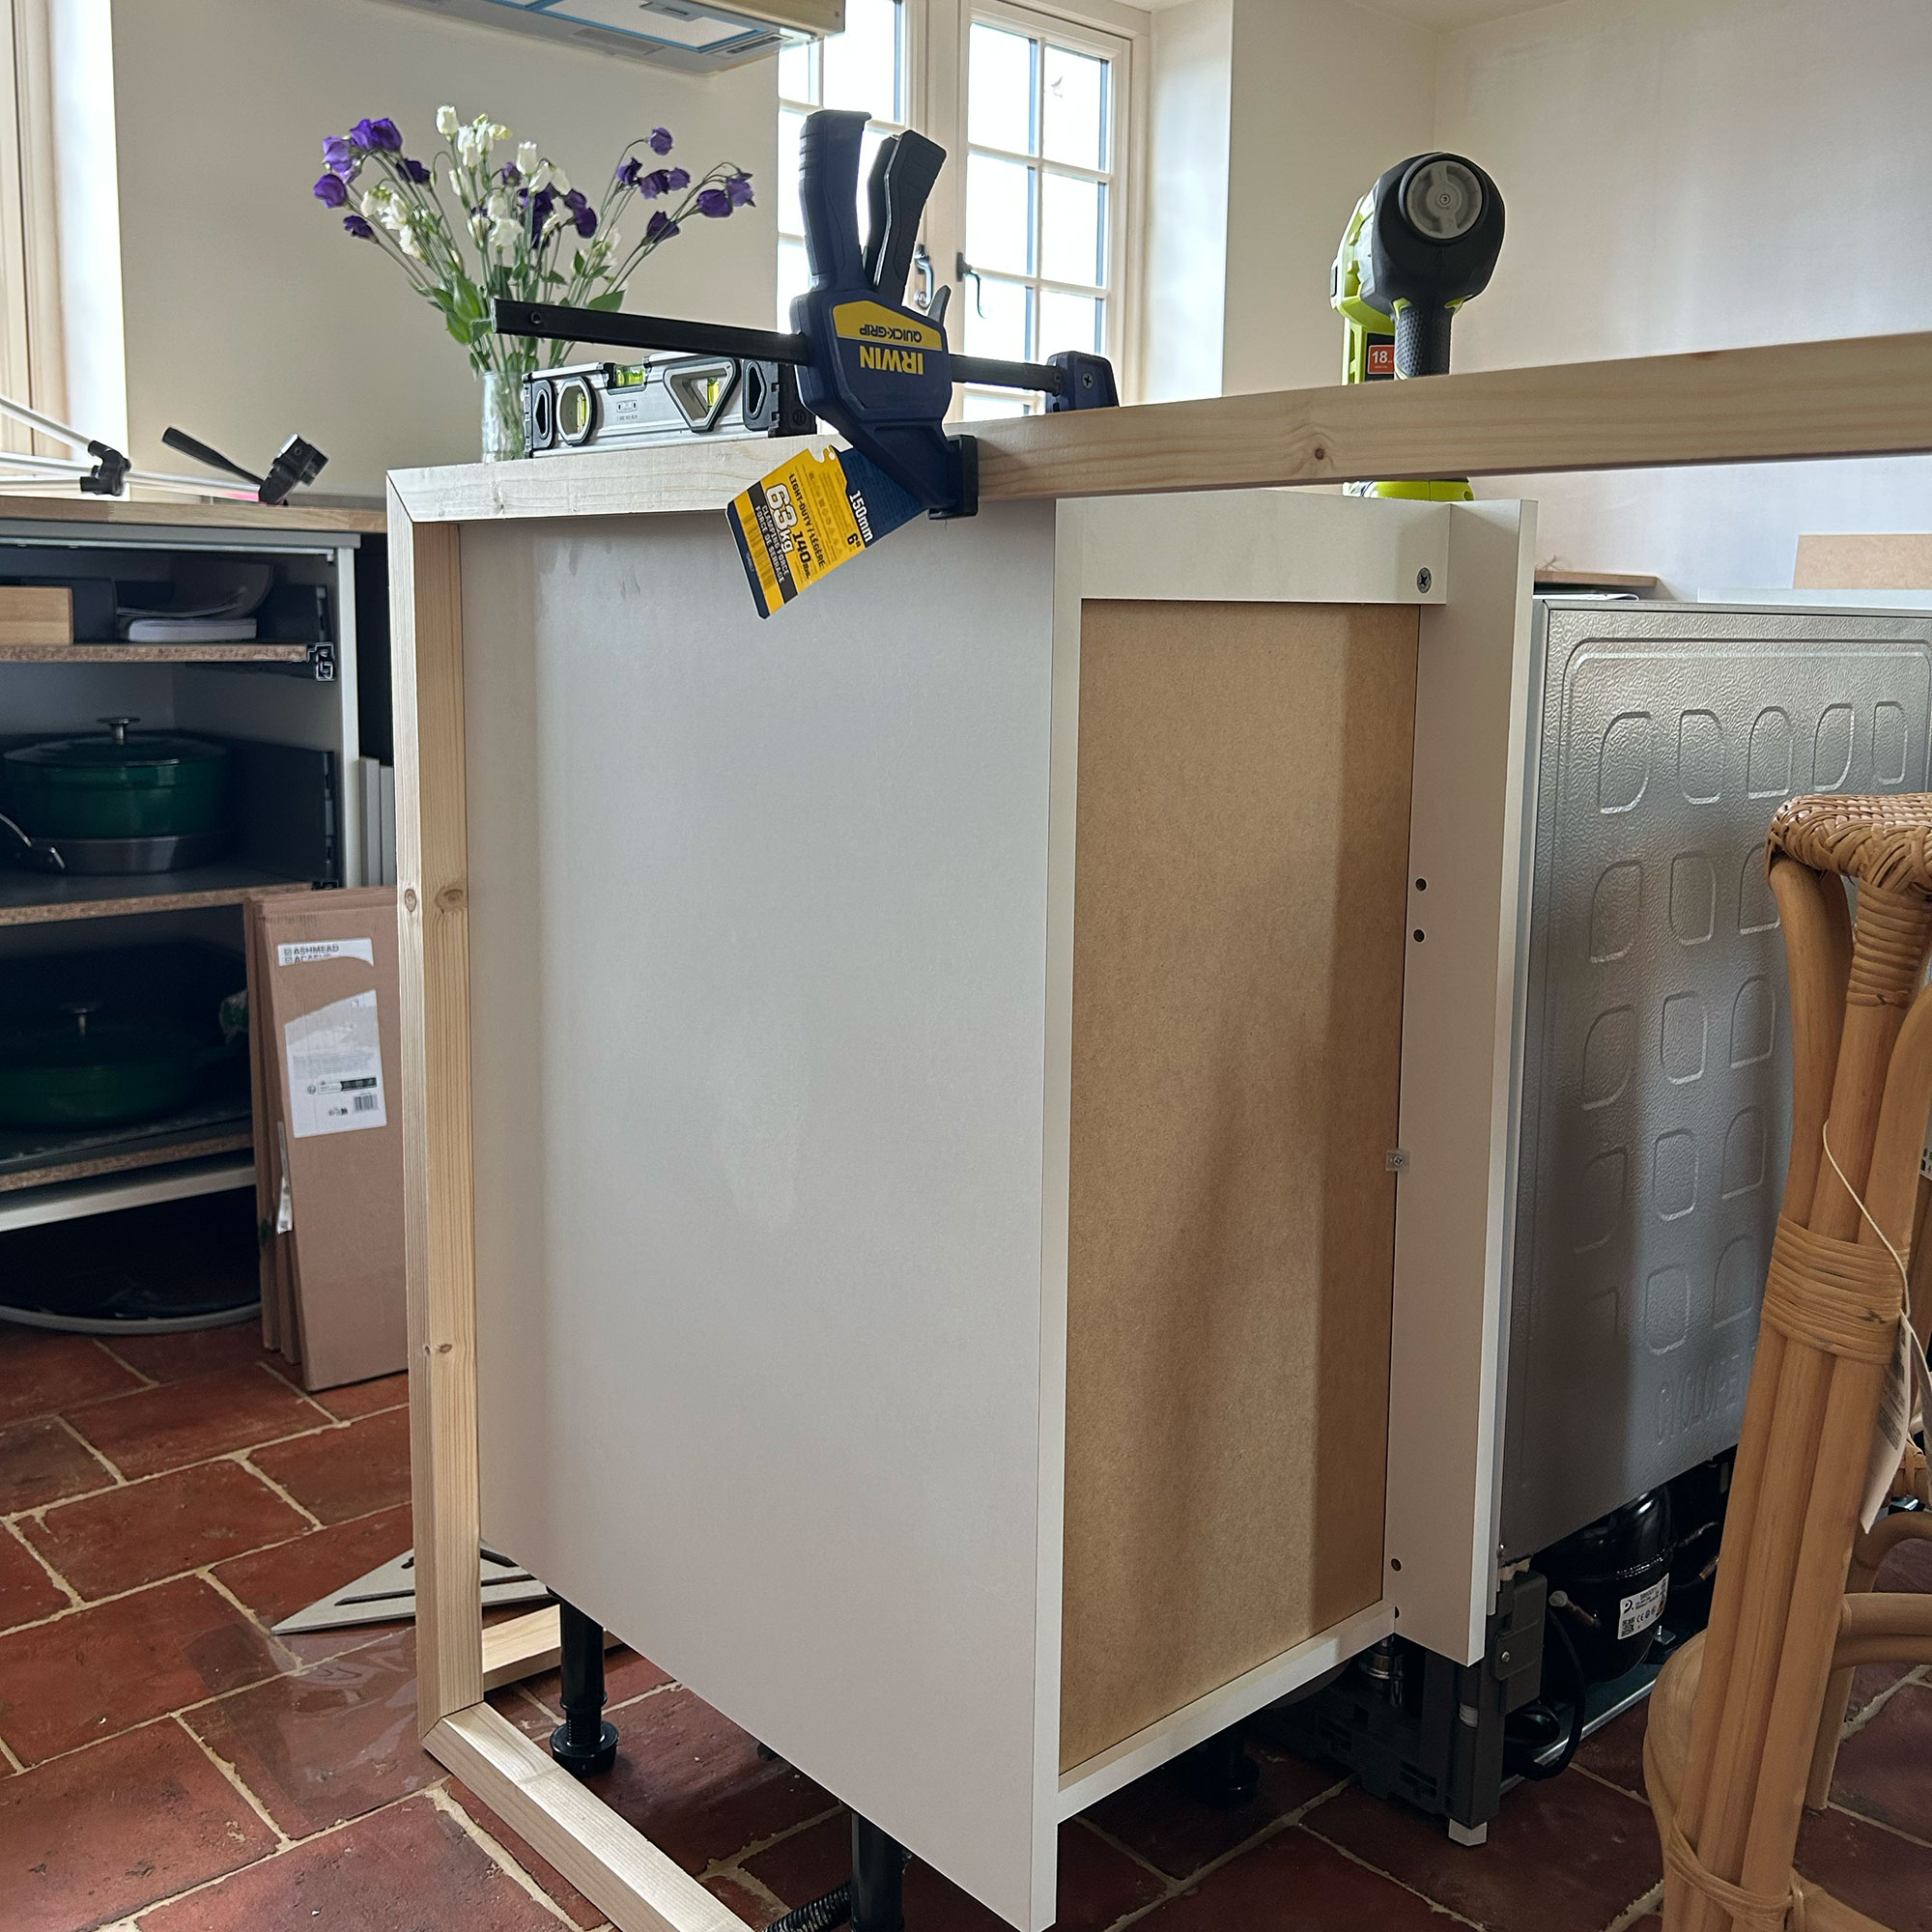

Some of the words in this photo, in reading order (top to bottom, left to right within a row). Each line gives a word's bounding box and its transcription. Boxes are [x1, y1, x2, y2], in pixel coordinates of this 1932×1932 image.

[859, 345, 924, 376] IRWIN
[1372, 351, 1388, 364] 18
[788, 473, 811, 526] LIGHT-DUTY
[755, 506, 770, 536] FORCE
[849, 490, 874, 543] 150mm
[761, 504, 781, 549] CLAMPING
[777, 548, 790, 576] FORCE
[764, 534, 773, 546] DE
[768, 546, 785, 583] SERRAGE
[294, 944, 340, 955] ASHMEAD
